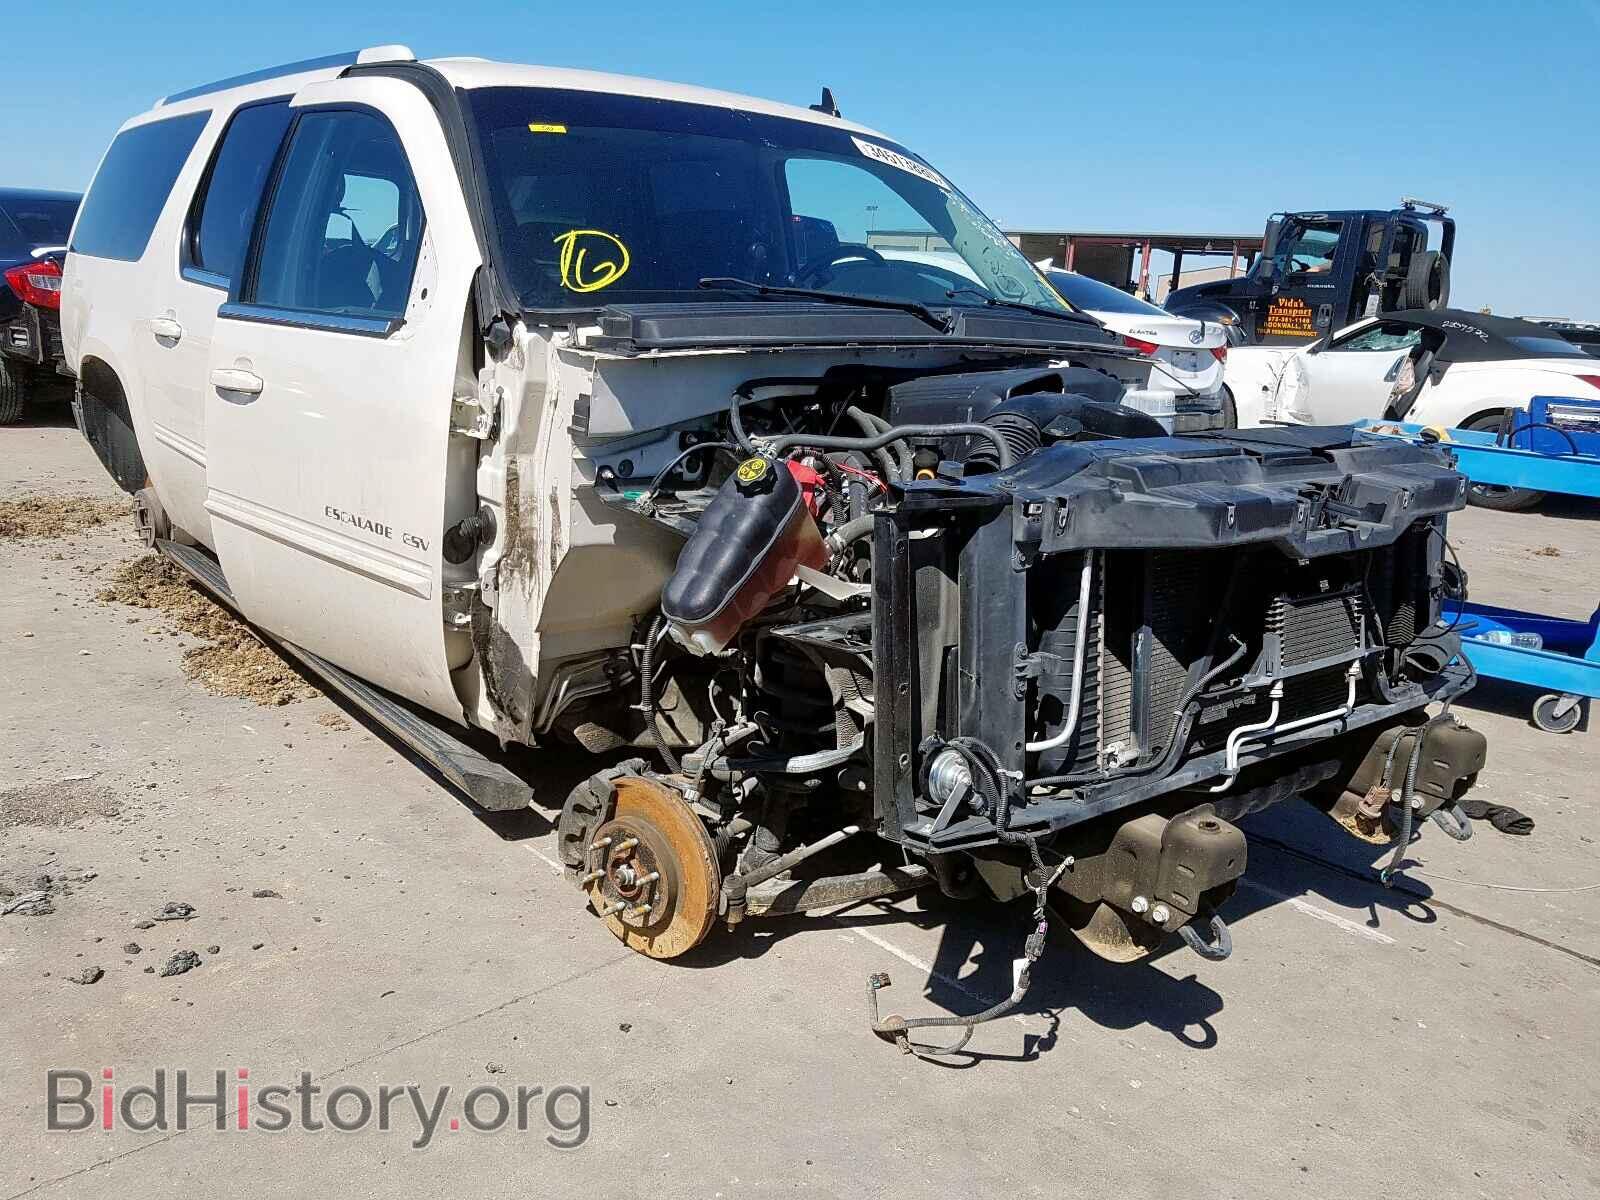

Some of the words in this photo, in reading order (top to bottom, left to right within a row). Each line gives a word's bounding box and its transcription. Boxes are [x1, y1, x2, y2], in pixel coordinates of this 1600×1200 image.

[1278, 297, 1305, 308] Vida's
[1267, 304, 1313, 317] Transport
[324, 505, 393, 540] ESCALADE
[402, 532, 431, 552] ESV
